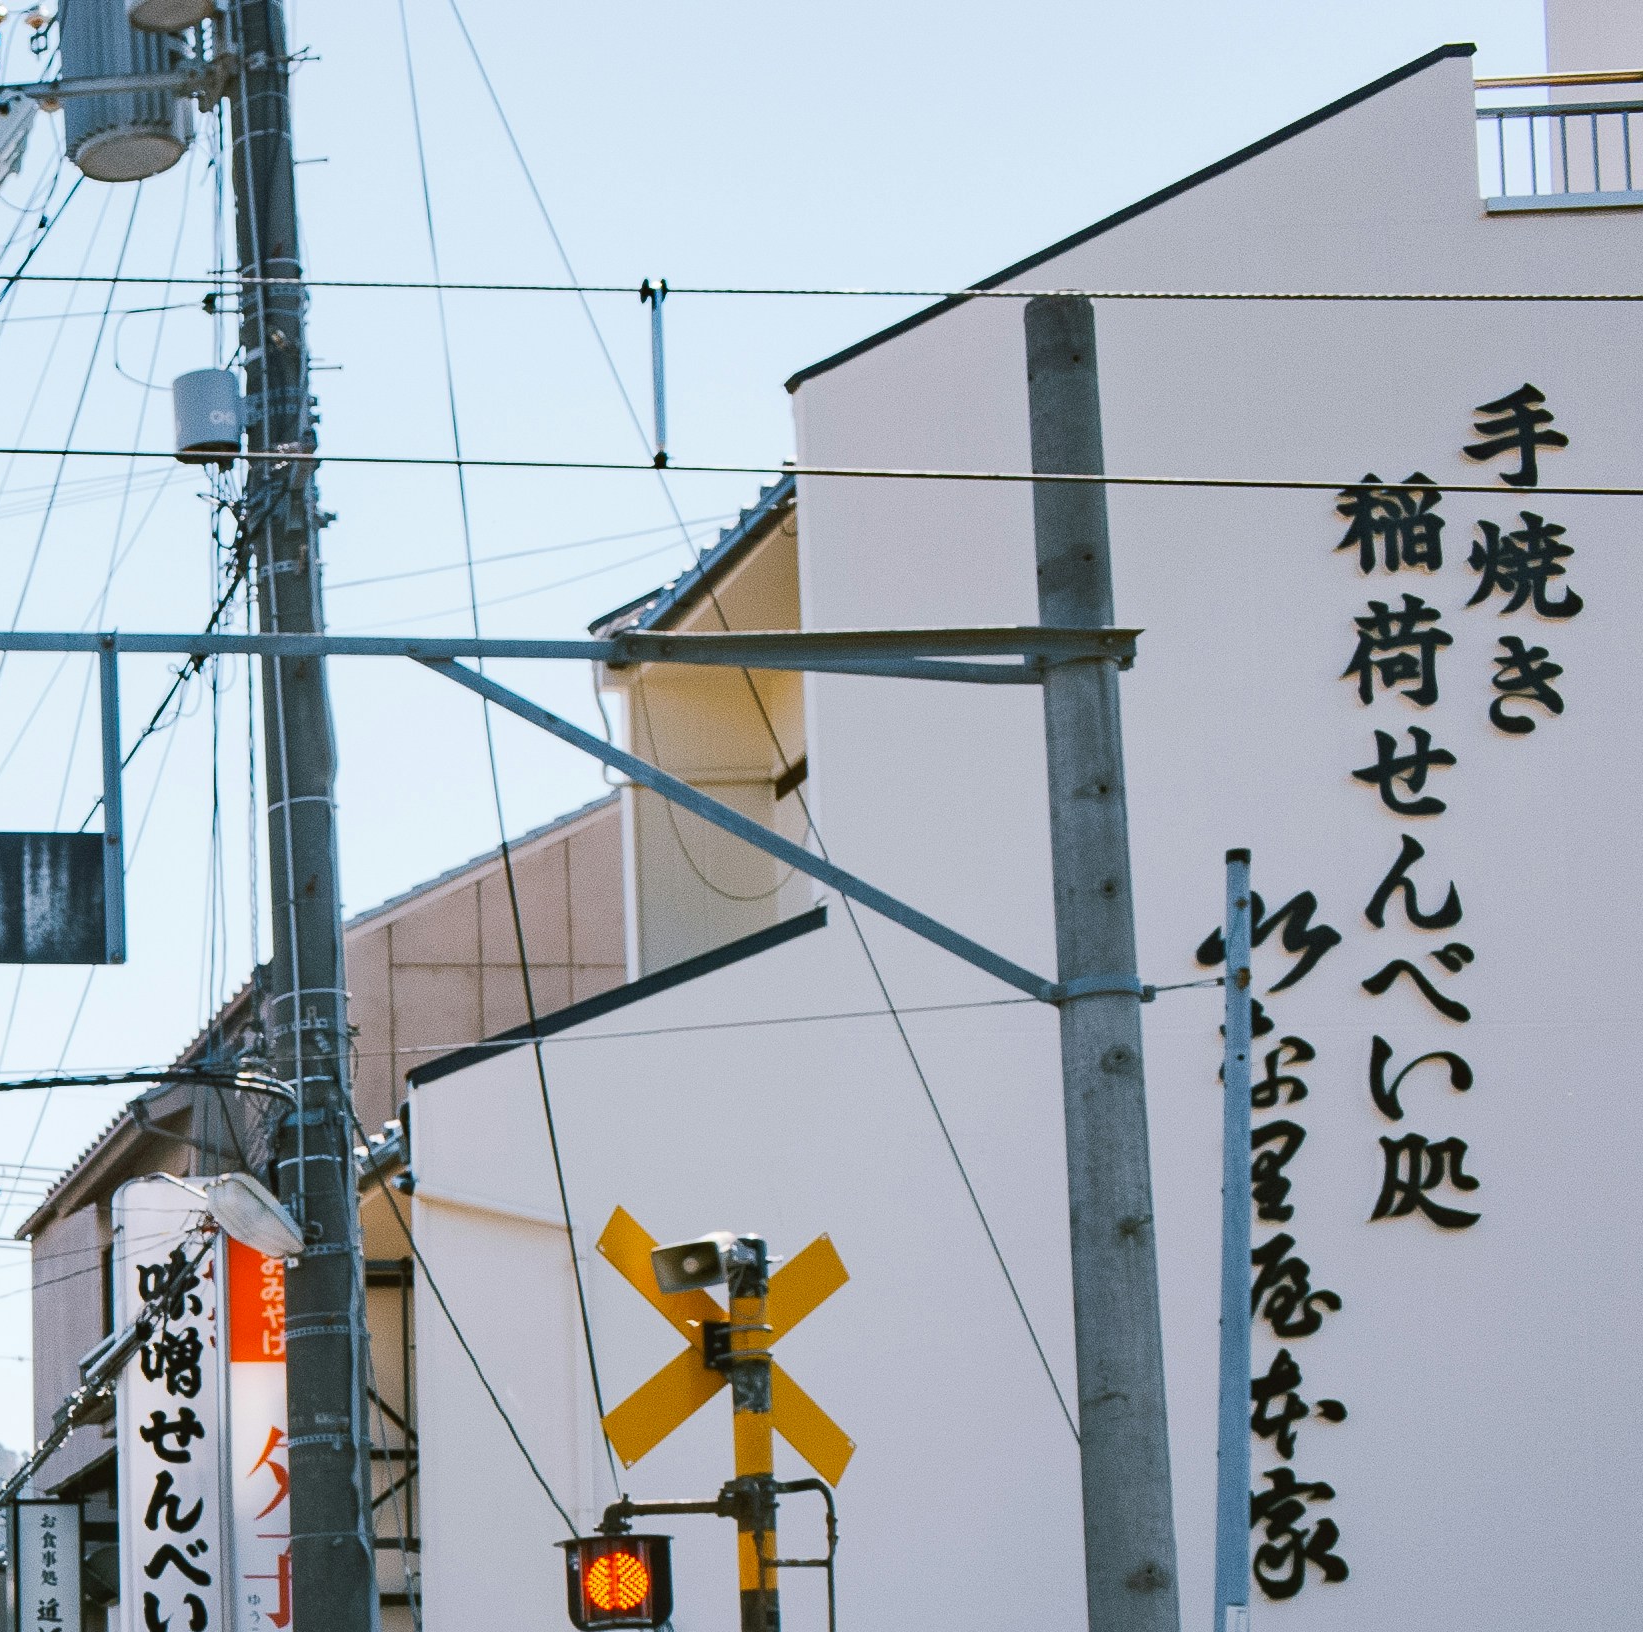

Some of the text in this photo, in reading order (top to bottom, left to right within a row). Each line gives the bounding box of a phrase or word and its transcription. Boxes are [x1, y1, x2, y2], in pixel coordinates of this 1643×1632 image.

[1462, 383, 1584, 733] 手焼き
[1335, 472, 1482, 1229] 稲荷せんべい処
[40, 1513, 59, 1587] お食事処
